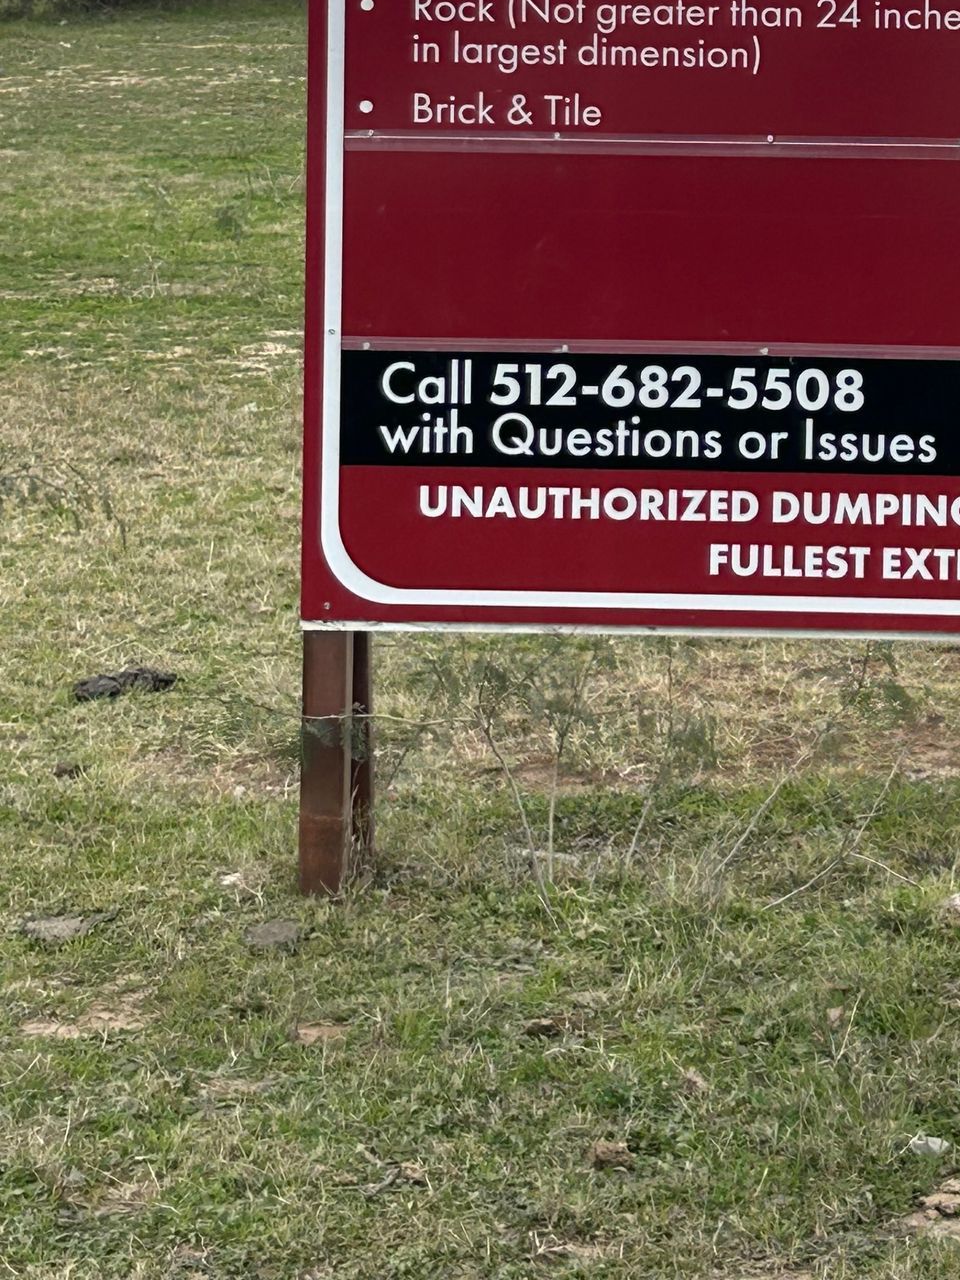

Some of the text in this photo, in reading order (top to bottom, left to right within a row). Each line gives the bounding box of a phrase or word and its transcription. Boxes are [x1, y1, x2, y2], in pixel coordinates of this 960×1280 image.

[596, 0, 720, 34] greater
[412, 30, 761, 75] in largest dimension)
[413, 91, 602, 127] Brick & Tile
[381, 358, 865, 412] Call 512-682-5508
[379, 408, 937, 463] with Questions or Issues
[419, 485, 759, 522] UNAUTHORIZED
[709, 543, 871, 579] FULLEST
